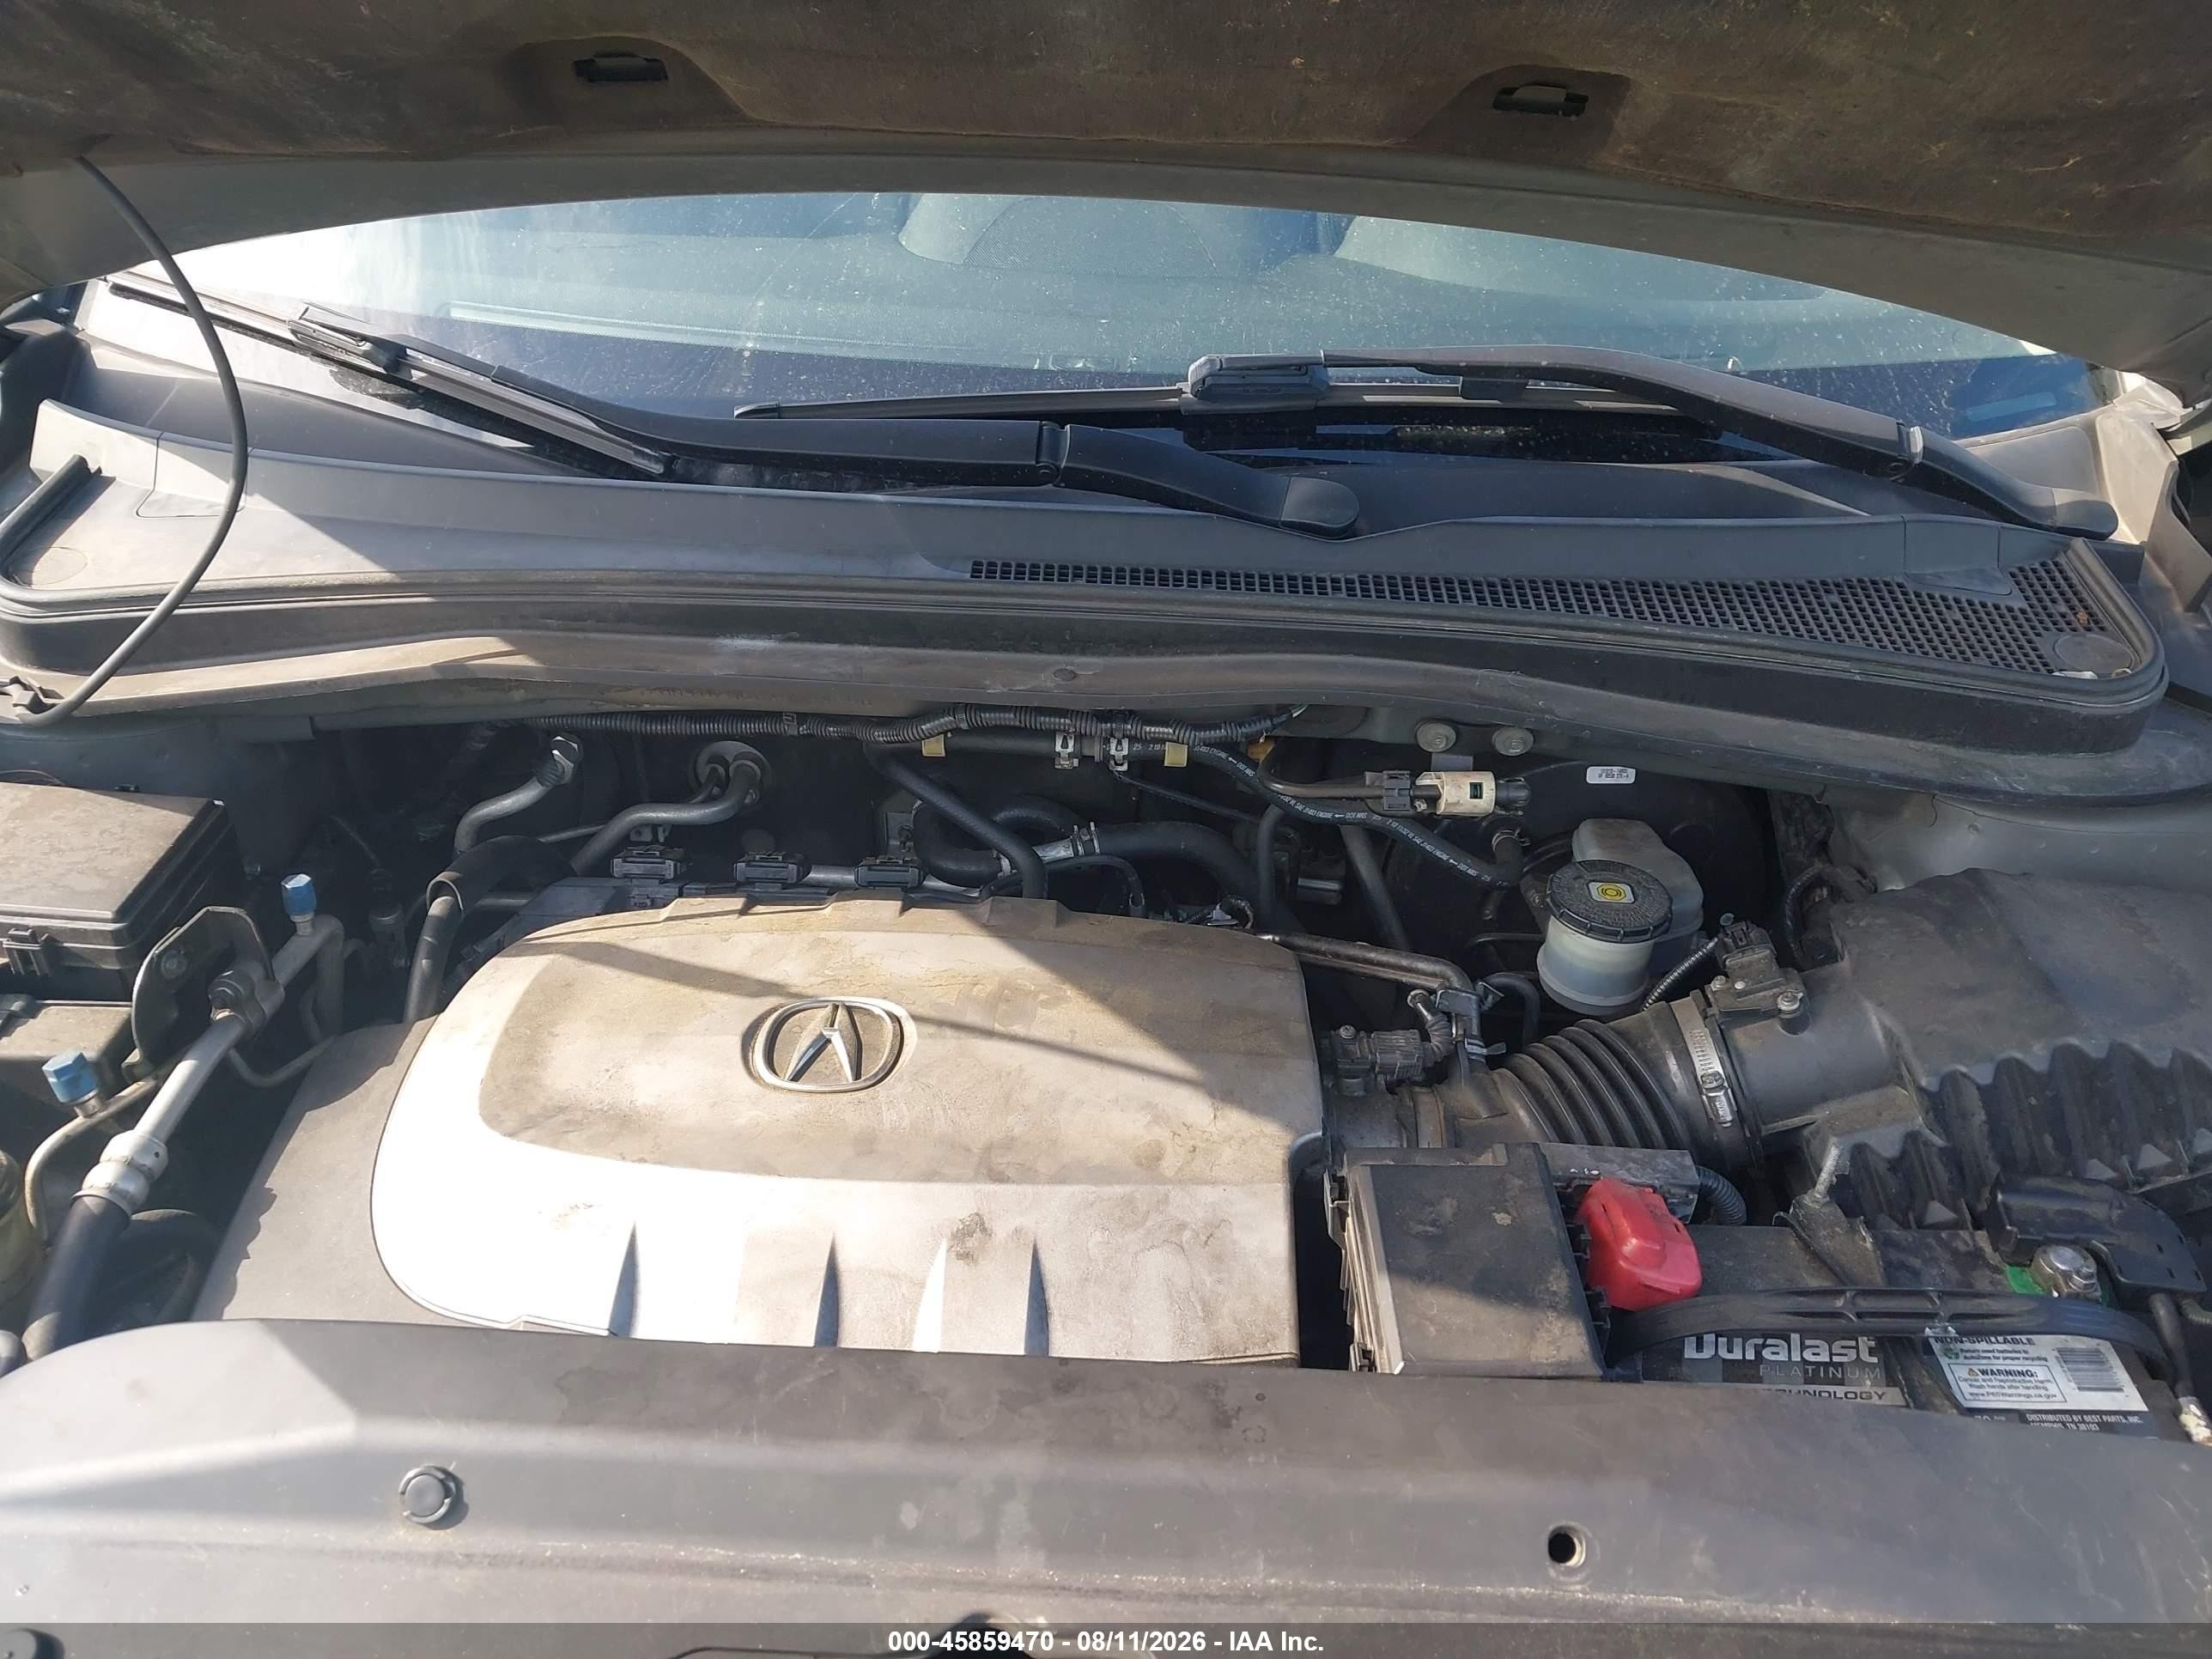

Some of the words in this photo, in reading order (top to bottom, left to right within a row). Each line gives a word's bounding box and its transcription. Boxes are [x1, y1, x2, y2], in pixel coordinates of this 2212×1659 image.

[1684, 1333, 1879, 1363] Duralast
[1759, 1364, 1881, 1379] PLATINUM
[1978, 1368, 2039, 1377] WARNING:
[2026, 1413, 2073, 1422] DISTRIBUTED
